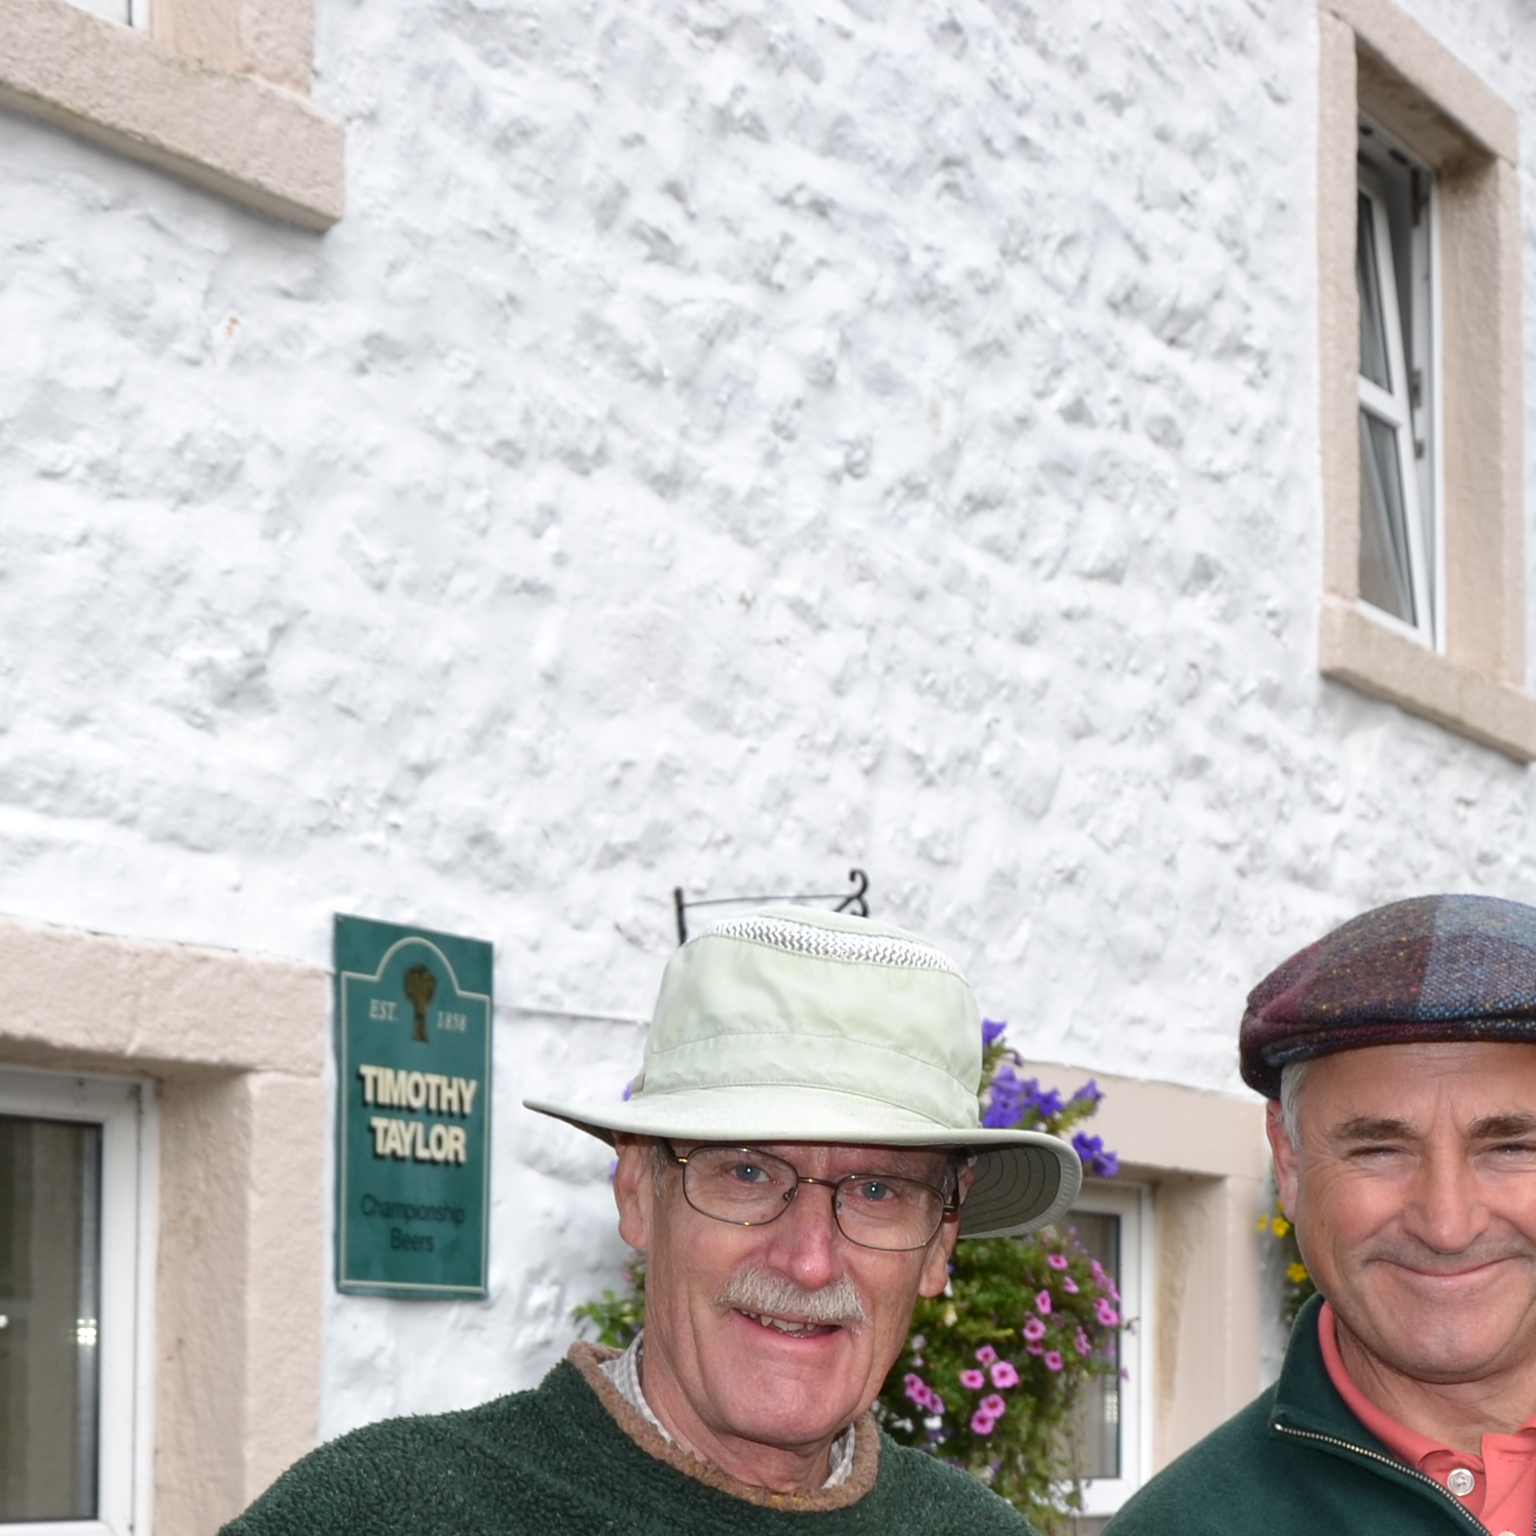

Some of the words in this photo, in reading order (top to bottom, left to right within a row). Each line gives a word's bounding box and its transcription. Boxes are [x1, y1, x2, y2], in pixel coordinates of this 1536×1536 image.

[359, 1064, 478, 1116] TIMOTHY
[370, 1117, 468, 1164] TAYLOR
[360, 1193, 465, 1226] Championship
[390, 1228, 435, 1252] Beers
